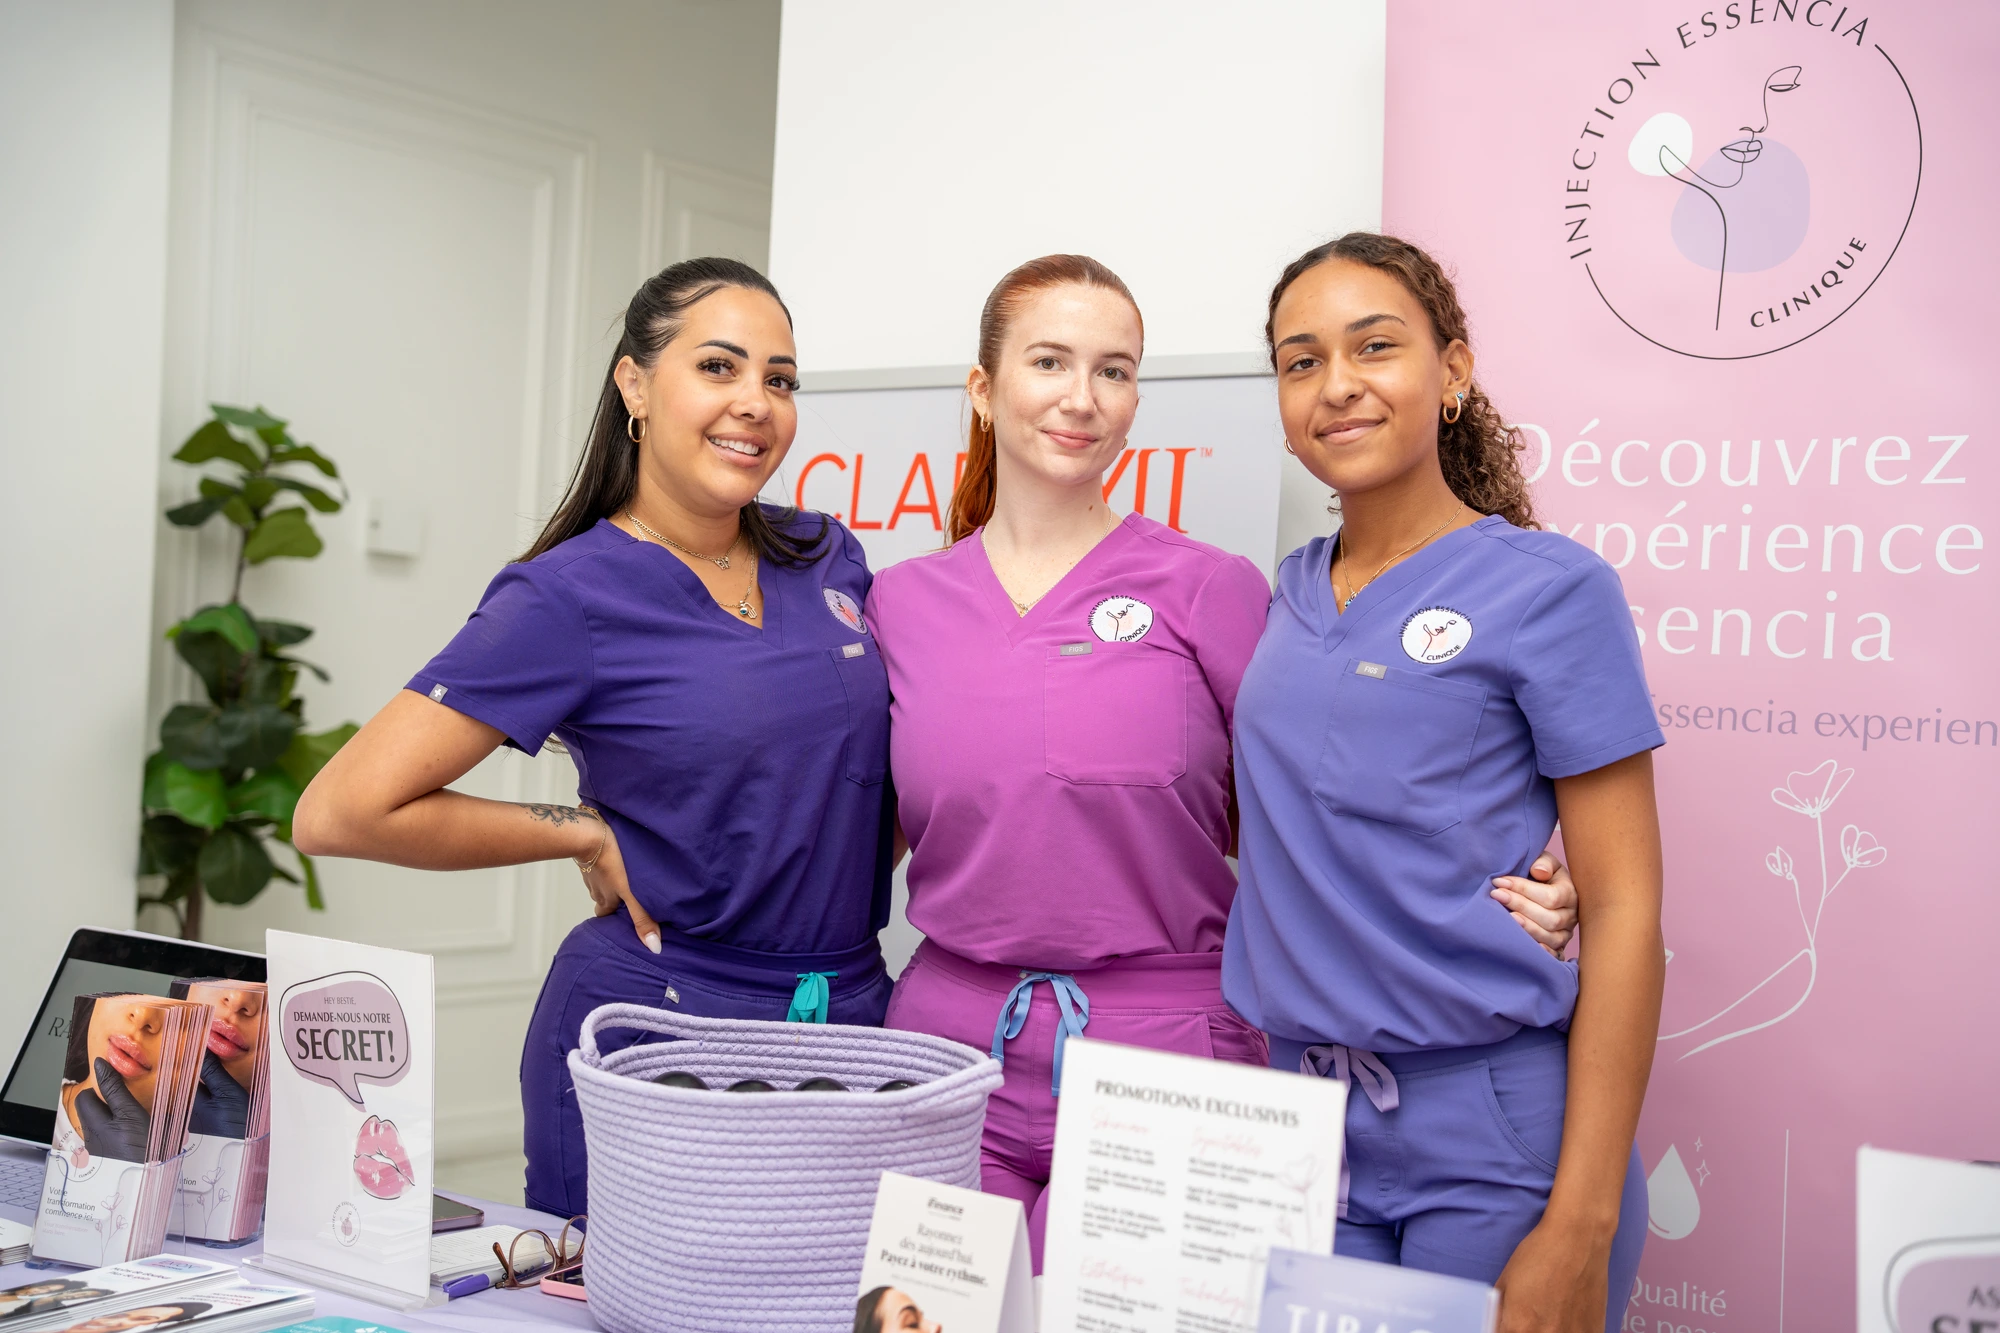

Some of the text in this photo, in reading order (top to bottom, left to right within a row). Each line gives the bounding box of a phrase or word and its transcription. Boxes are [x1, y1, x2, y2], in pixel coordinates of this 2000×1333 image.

[1565, 0, 1869, 260] INJECTION ESSENCIA
[1750, 237, 1867, 328] CLINIQUE
[1499, 418, 1969, 487] Découvrez
[1068, 645, 1084, 653] FIGS
[1426, 644, 1461, 661] CLINIQUE
[1363, 665, 1379, 675] FIGS
[1652, 694, 1998, 751] ssencia experien
[293, 1010, 392, 1024] DEMANDE-NOUS NOTRE
[323, 996, 357, 1006] HEY BESTIE,
[295, 1027, 396, 1064] SECRET!
[1094, 1079, 1300, 1128] PROMOTIONS EXCLUSIVES
[880, 1249, 909, 1269] Payez
[910, 1254, 917, 1268] à
[919, 1261, 945, 1276] votre
